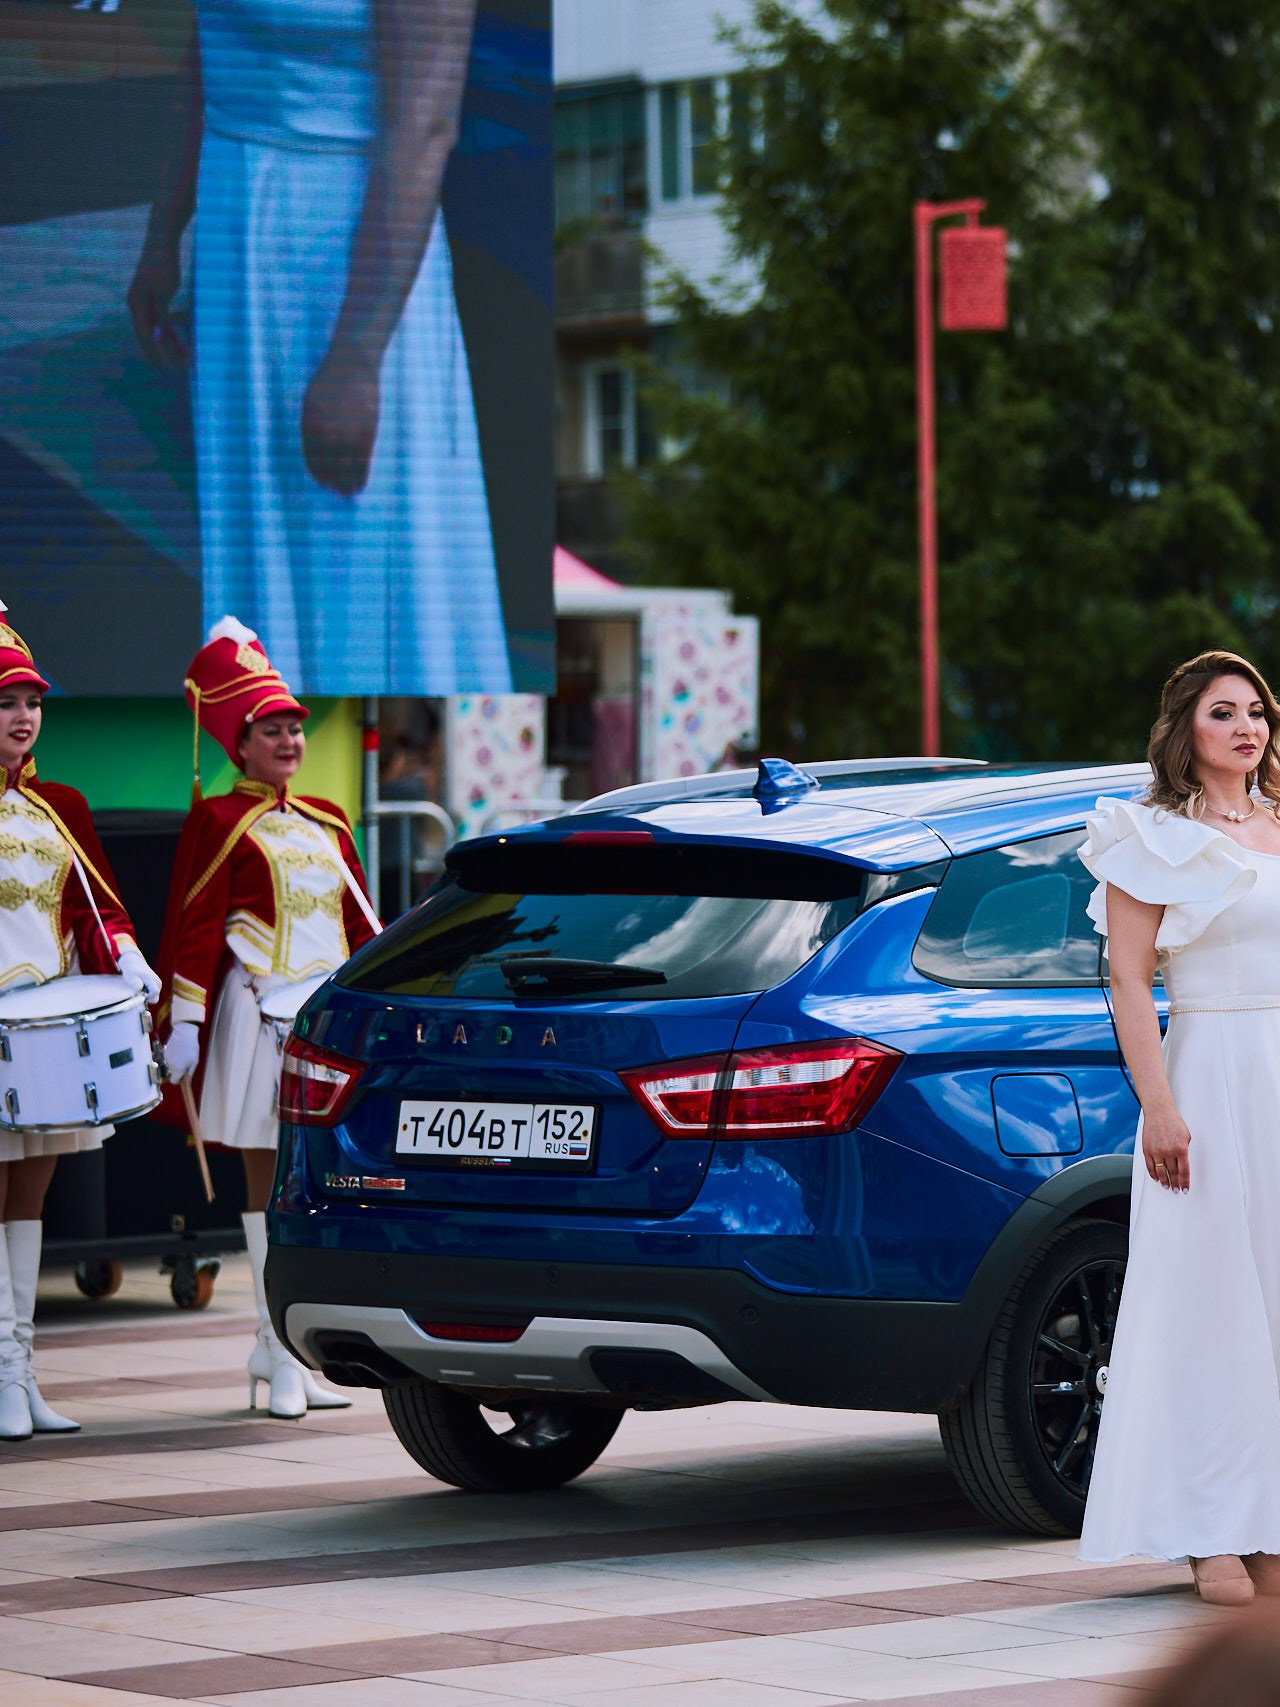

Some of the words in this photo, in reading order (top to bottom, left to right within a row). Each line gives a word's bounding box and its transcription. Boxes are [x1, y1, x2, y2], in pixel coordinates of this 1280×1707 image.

[416, 1023, 557, 1046] LADA
[537, 1109, 584, 1140] 152
[545, 1142, 568, 1154] RUS
